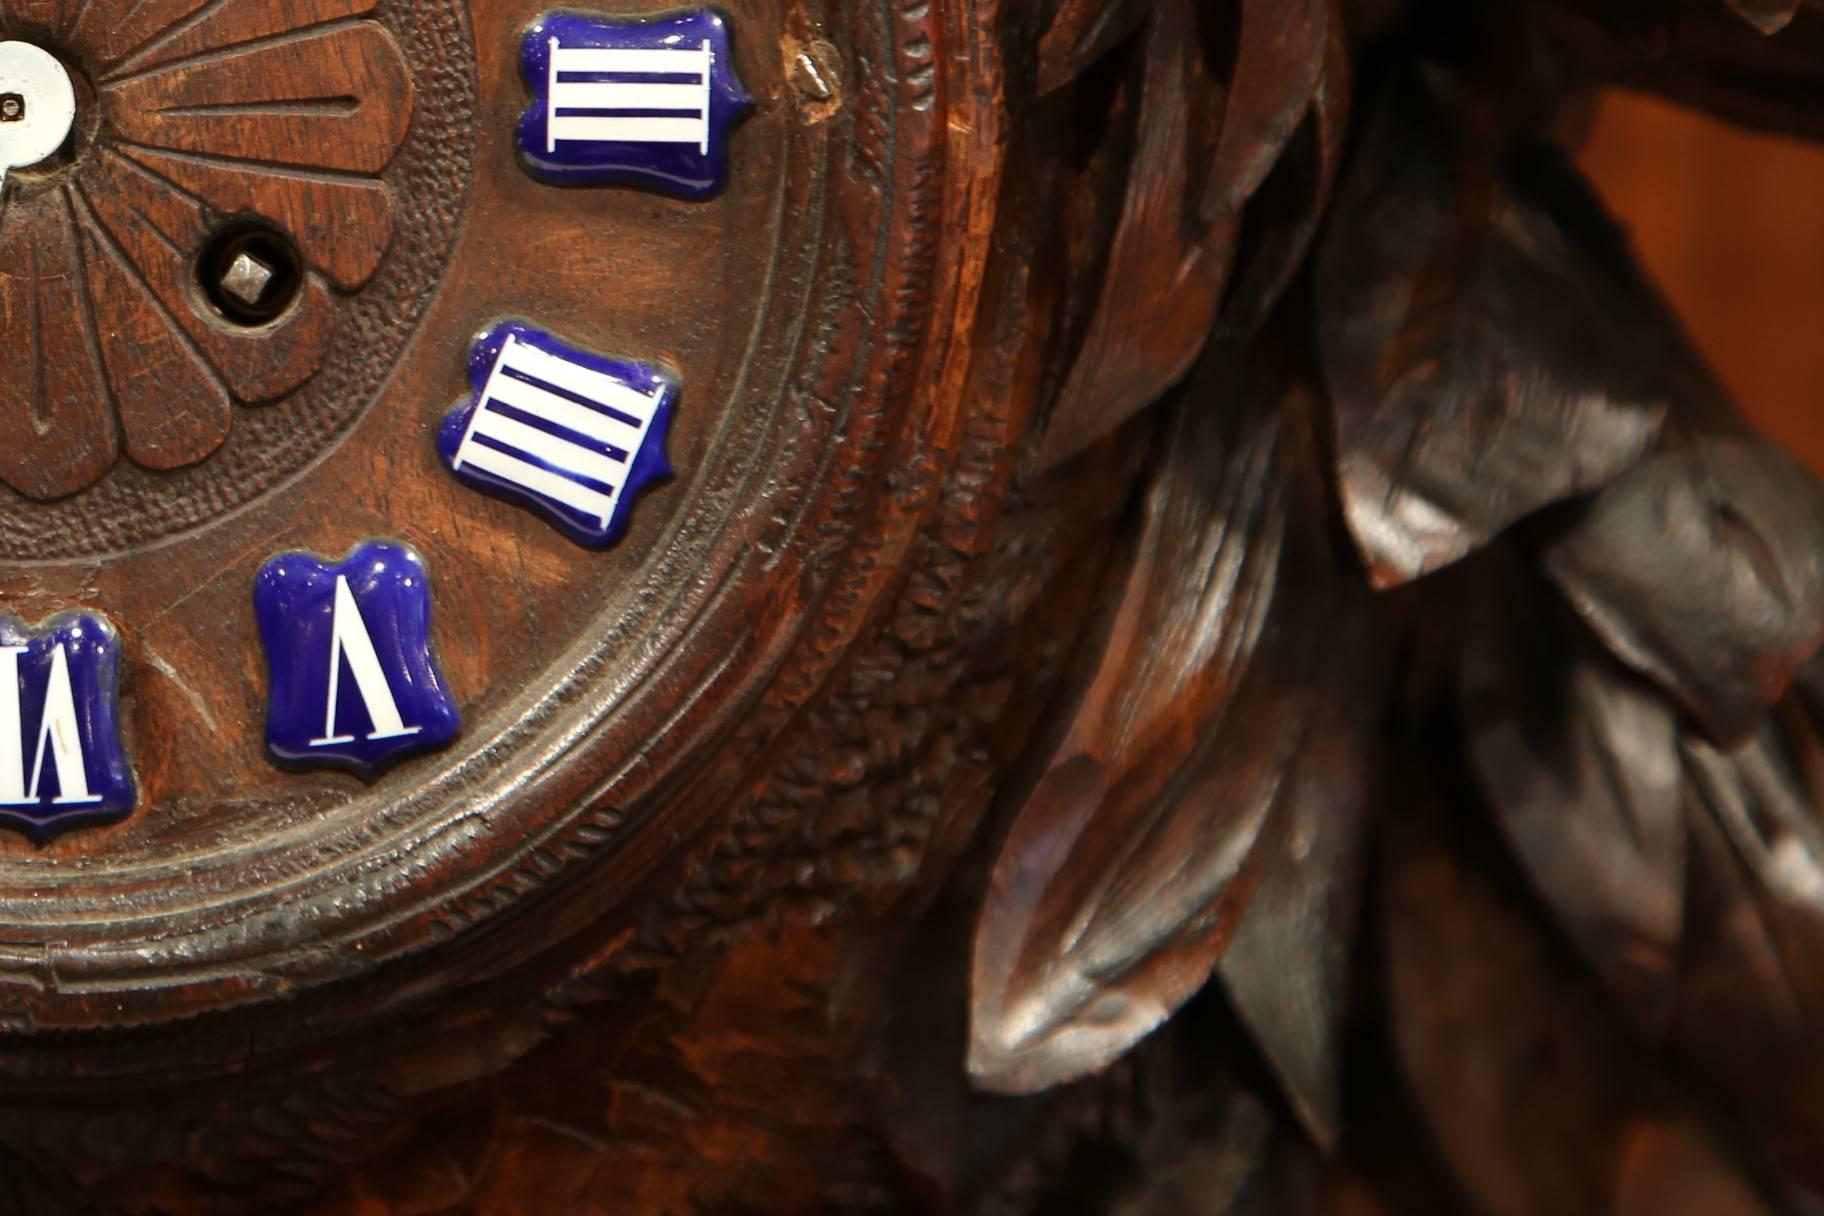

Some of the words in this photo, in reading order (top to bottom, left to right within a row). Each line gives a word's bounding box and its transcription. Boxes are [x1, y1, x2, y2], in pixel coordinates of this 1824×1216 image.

[548, 38, 715, 155] III
[453, 335, 666, 530] IIII
[310, 575, 421, 745] V
